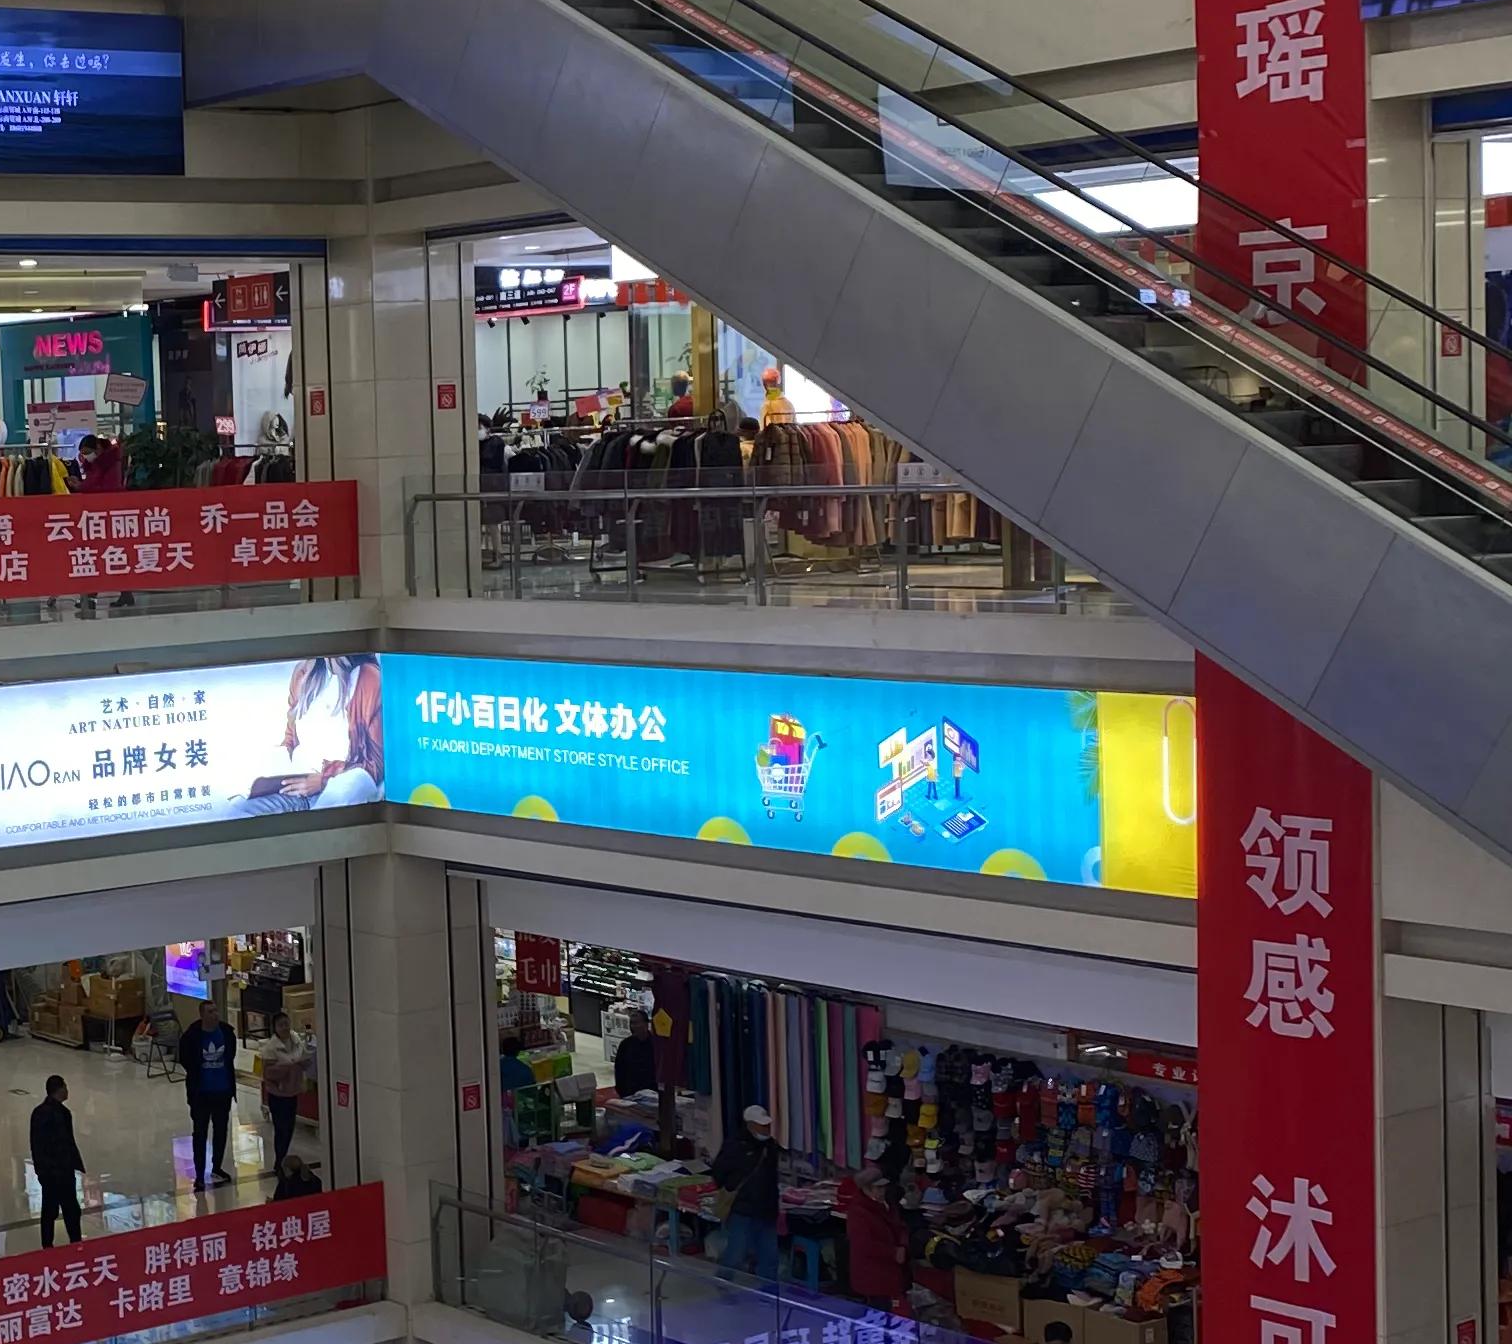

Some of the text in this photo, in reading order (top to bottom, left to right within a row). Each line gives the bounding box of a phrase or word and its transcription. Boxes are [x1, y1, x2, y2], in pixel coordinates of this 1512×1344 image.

[33, 330, 104, 358] NEWS
[43, 506, 171, 544] 云佰丽尚
[199, 498, 320, 535] 乔一品会
[68, 542, 195, 579] 蓝色夏天
[231, 534, 320, 567] 卓天妮
[68, 709, 208, 735] ART NATURE HOME
[554, 698, 667, 743] 文体办公
[92, 738, 209, 779] 品牌女装
[471, 740, 552, 762] DEPARTMENT
[553, 750, 596, 767] STORE
[597, 752, 639, 771] STYLE
[641, 757, 691, 776] OFFICE
[1240, 805, 1335, 1040] 领感
[1, 1254, 120, 1307] 密水云天
[144, 1230, 228, 1275] 胖得丽
[251, 1209, 333, 1253] 铭典屋
[109, 1273, 193, 1320] 卡路里
[217, 1252, 300, 1295] 意锦缘
